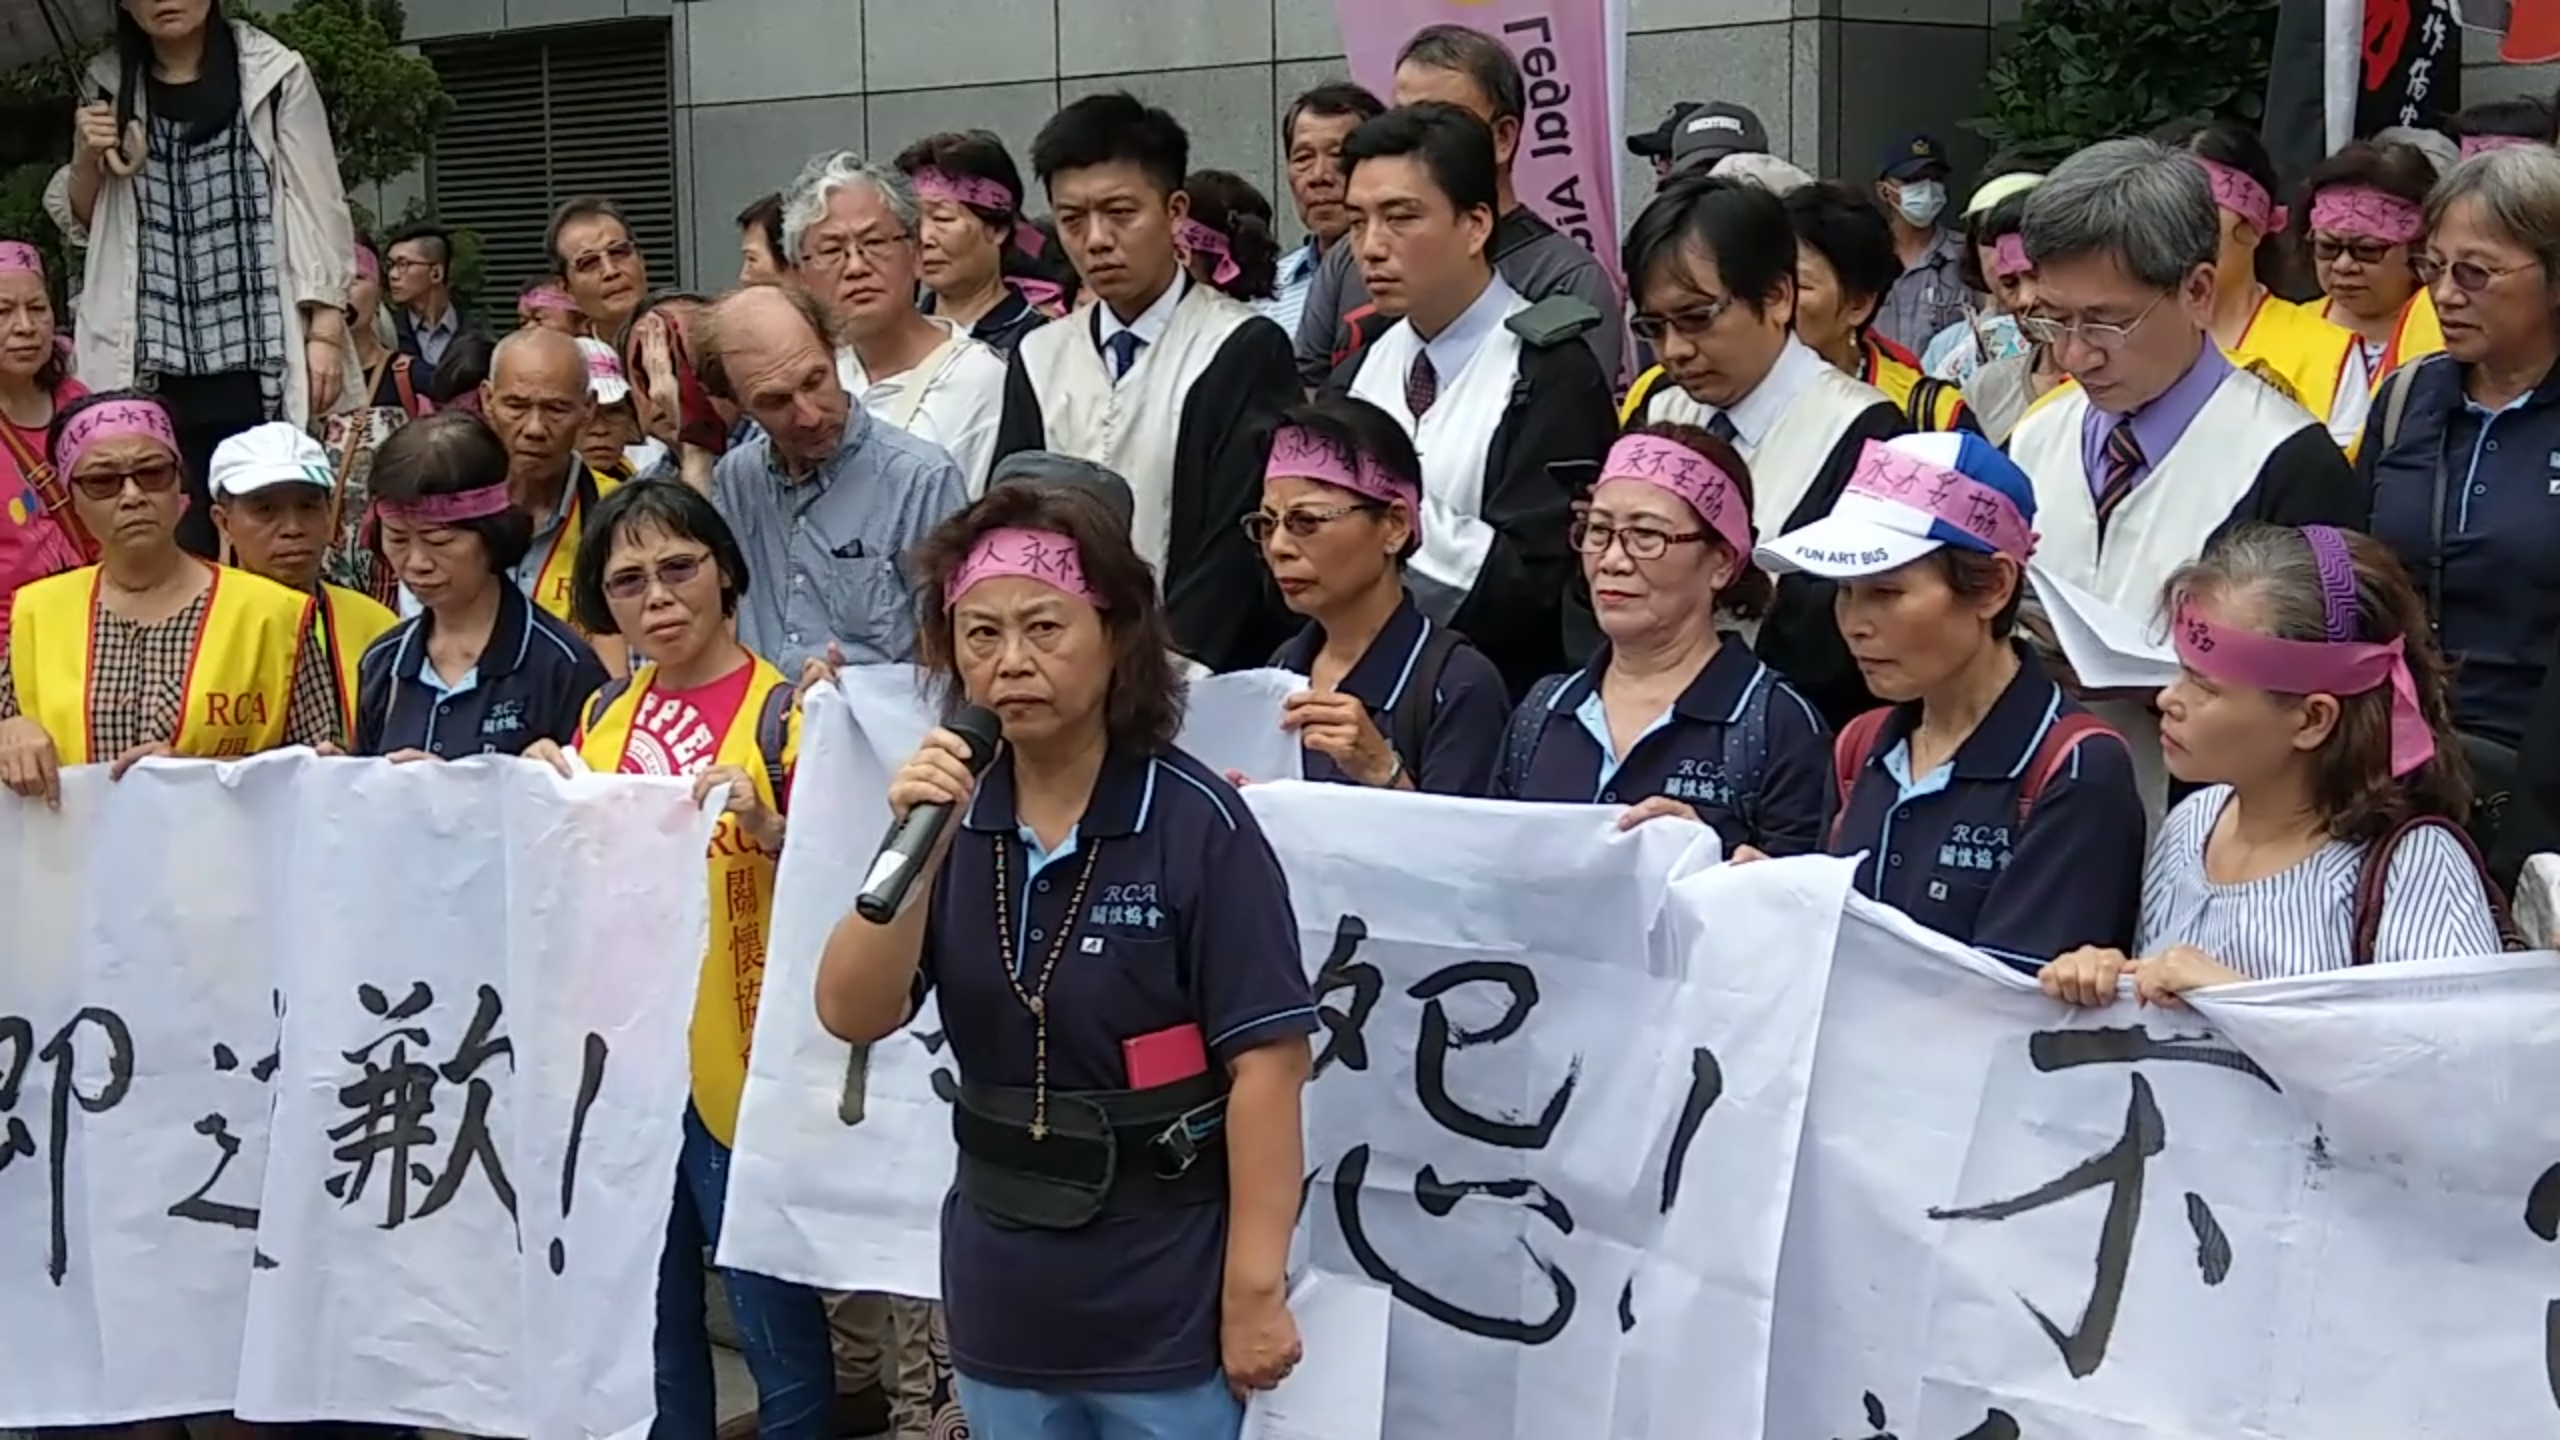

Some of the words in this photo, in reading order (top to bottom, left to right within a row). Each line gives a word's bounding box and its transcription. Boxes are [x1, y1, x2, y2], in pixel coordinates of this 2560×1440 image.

[1618, 442, 1726, 520] 永不妥協
[1795, 545, 1824, 562] FUN
[1828, 549, 1857, 567] ART
[1860, 546, 1890, 567] BUS
[205, 692, 267, 727] RCA
[1951, 823, 2011, 847] RCA
[1102, 883, 1158, 902] RCA
